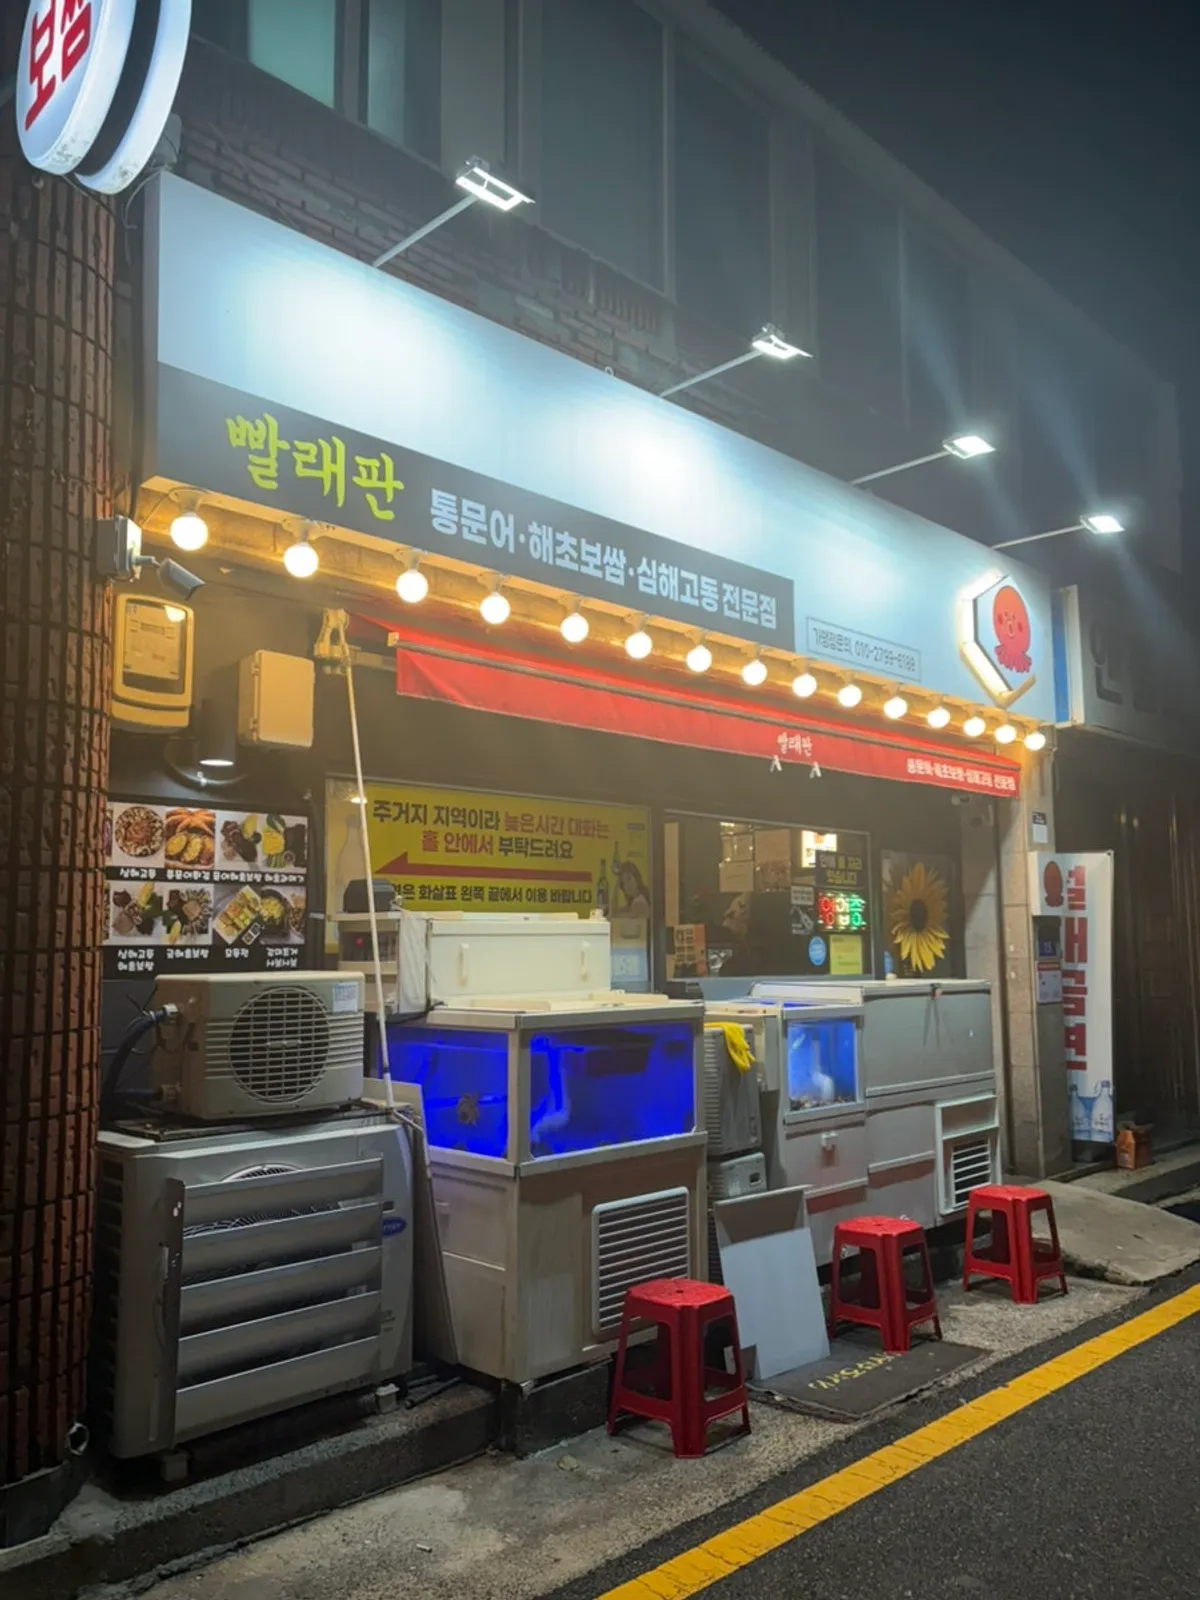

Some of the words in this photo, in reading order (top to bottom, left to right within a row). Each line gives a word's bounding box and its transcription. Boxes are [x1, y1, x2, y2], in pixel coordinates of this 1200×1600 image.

[226, 412, 404, 521] 빨래판
[722, 582, 777, 630] 전문점
[373, 800, 428, 825] 주거지
[433, 805, 501, 831] 지역이라
[567, 817, 610, 840] 대화는
[421, 830, 439, 853] 홀
[443, 832, 494, 855] 안에서
[498, 836, 574, 860] 부탁드려요
[418, 884, 457, 902] 화살표
[460, 885, 485, 903] 왼쪽
[487, 886, 523, 904] 끝에서
[525, 887, 548, 904] 이용
[550, 888, 593, 905] 바랍니다
